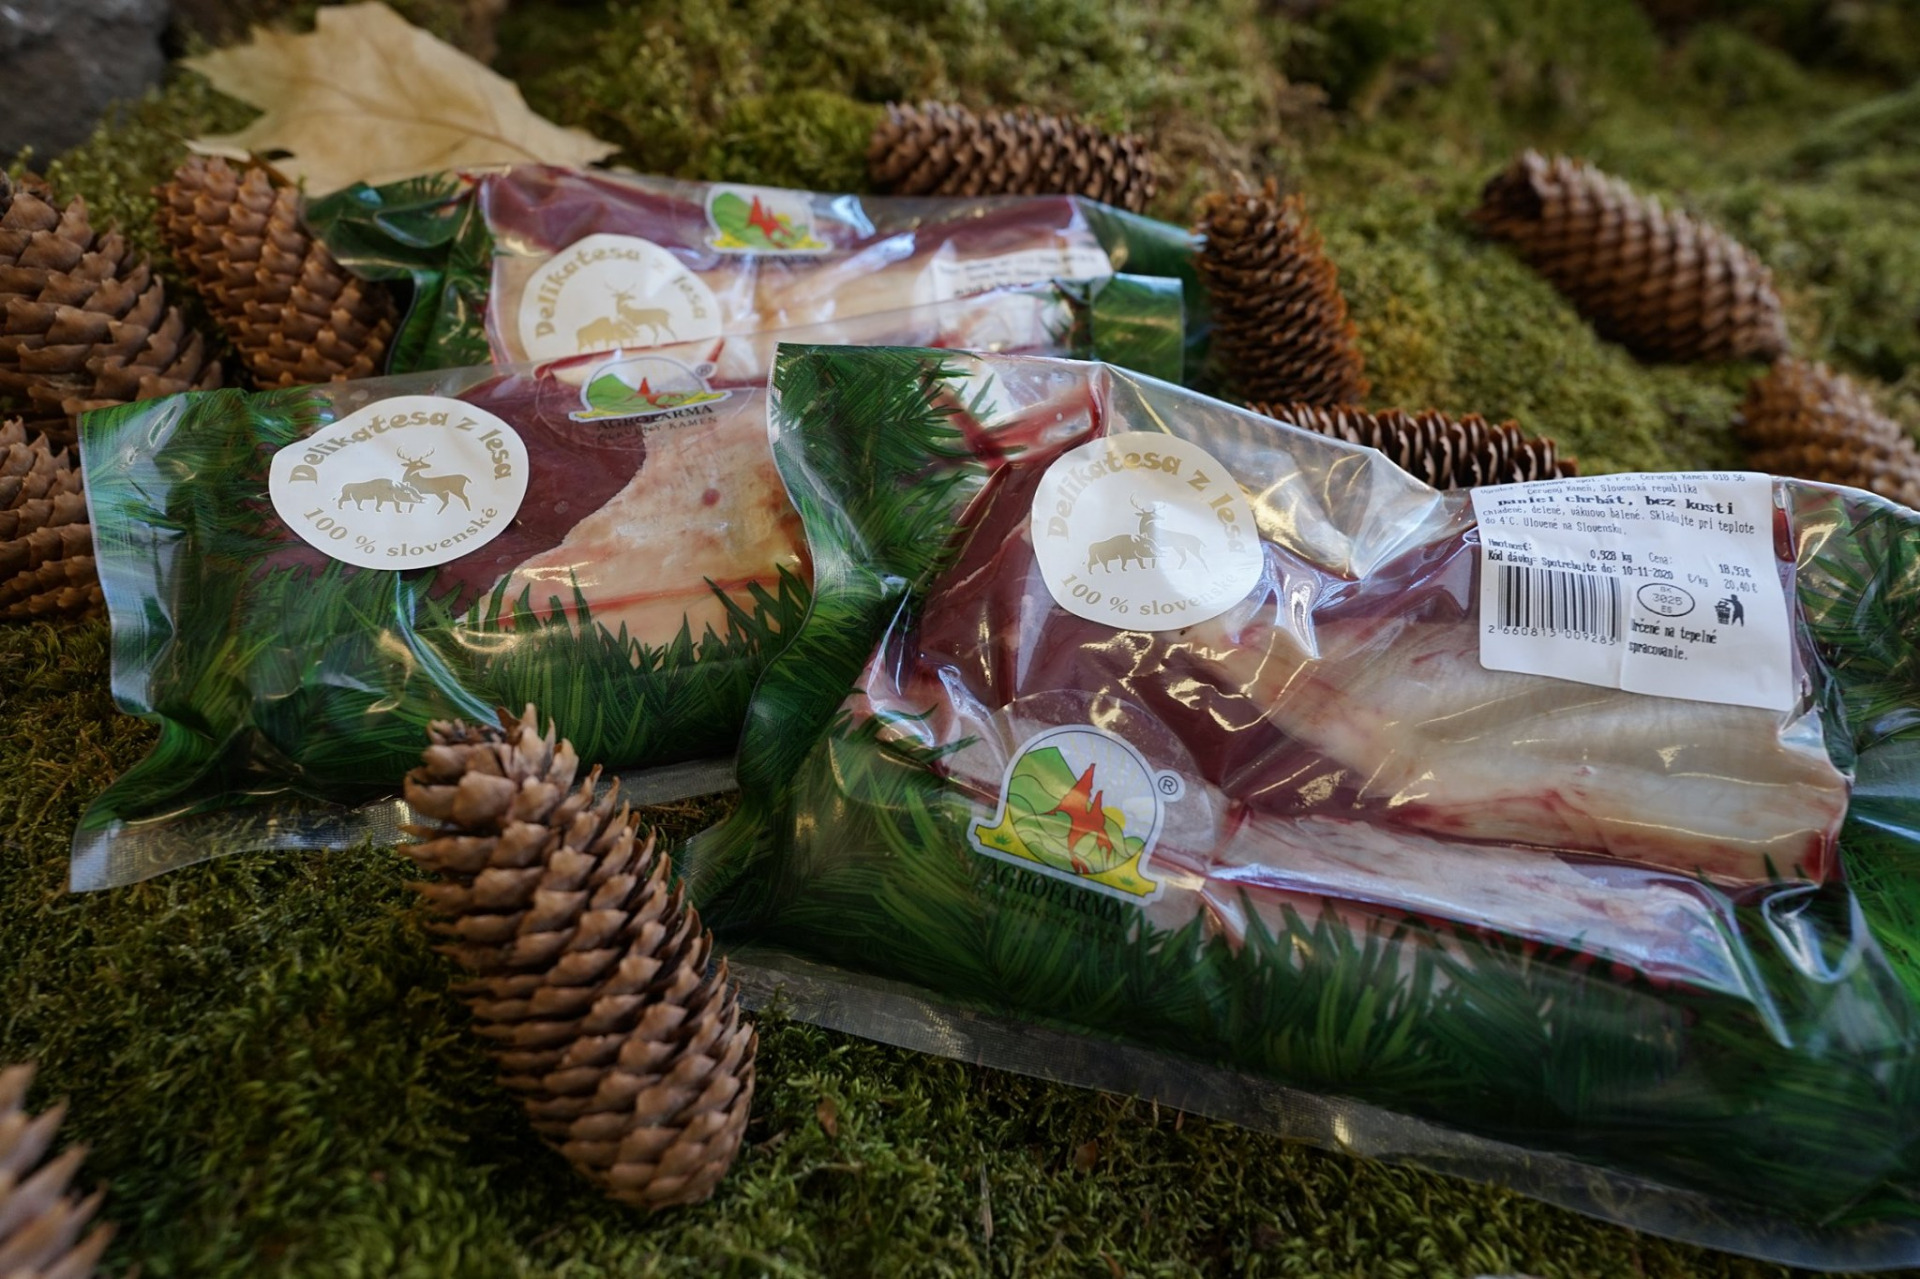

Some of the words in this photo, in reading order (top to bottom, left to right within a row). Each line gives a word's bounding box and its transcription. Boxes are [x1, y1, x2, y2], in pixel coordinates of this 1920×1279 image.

[288, 411, 450, 485] Delikatesa
[455, 416, 479, 432] z
[477, 429, 512, 481] lesa
[1047, 450, 1183, 542] Delikatesa
[1187, 469, 1211, 492] z
[1209, 493, 1247, 554] lesa
[1645, 495, 1676, 507] bez
[1685, 498, 1735, 515] kosti
[1651, 484, 1698, 494] republika
[304, 506, 348, 542] 100
[355, 534, 377, 555] %
[386, 506, 499, 557] slovenské
[1562, 521, 1573, 531] na
[1570, 504, 1606, 518] vákuovo
[1698, 517, 1713, 530] pri
[1718, 520, 1755, 535] teplote
[1488, 547, 1503, 562] Kód
[1541, 557, 1597, 573] Spotrebujte
[1622, 565, 1674, 580] 10-11-2020
[1061, 573, 1101, 605] 100
[1109, 596, 1129, 615] %
[1651, 592, 1683, 606] 3025
[1664, 626, 1675, 638] na
[1680, 629, 1717, 644] tepelné
[984, 861, 1123, 925] AGROFARMA
